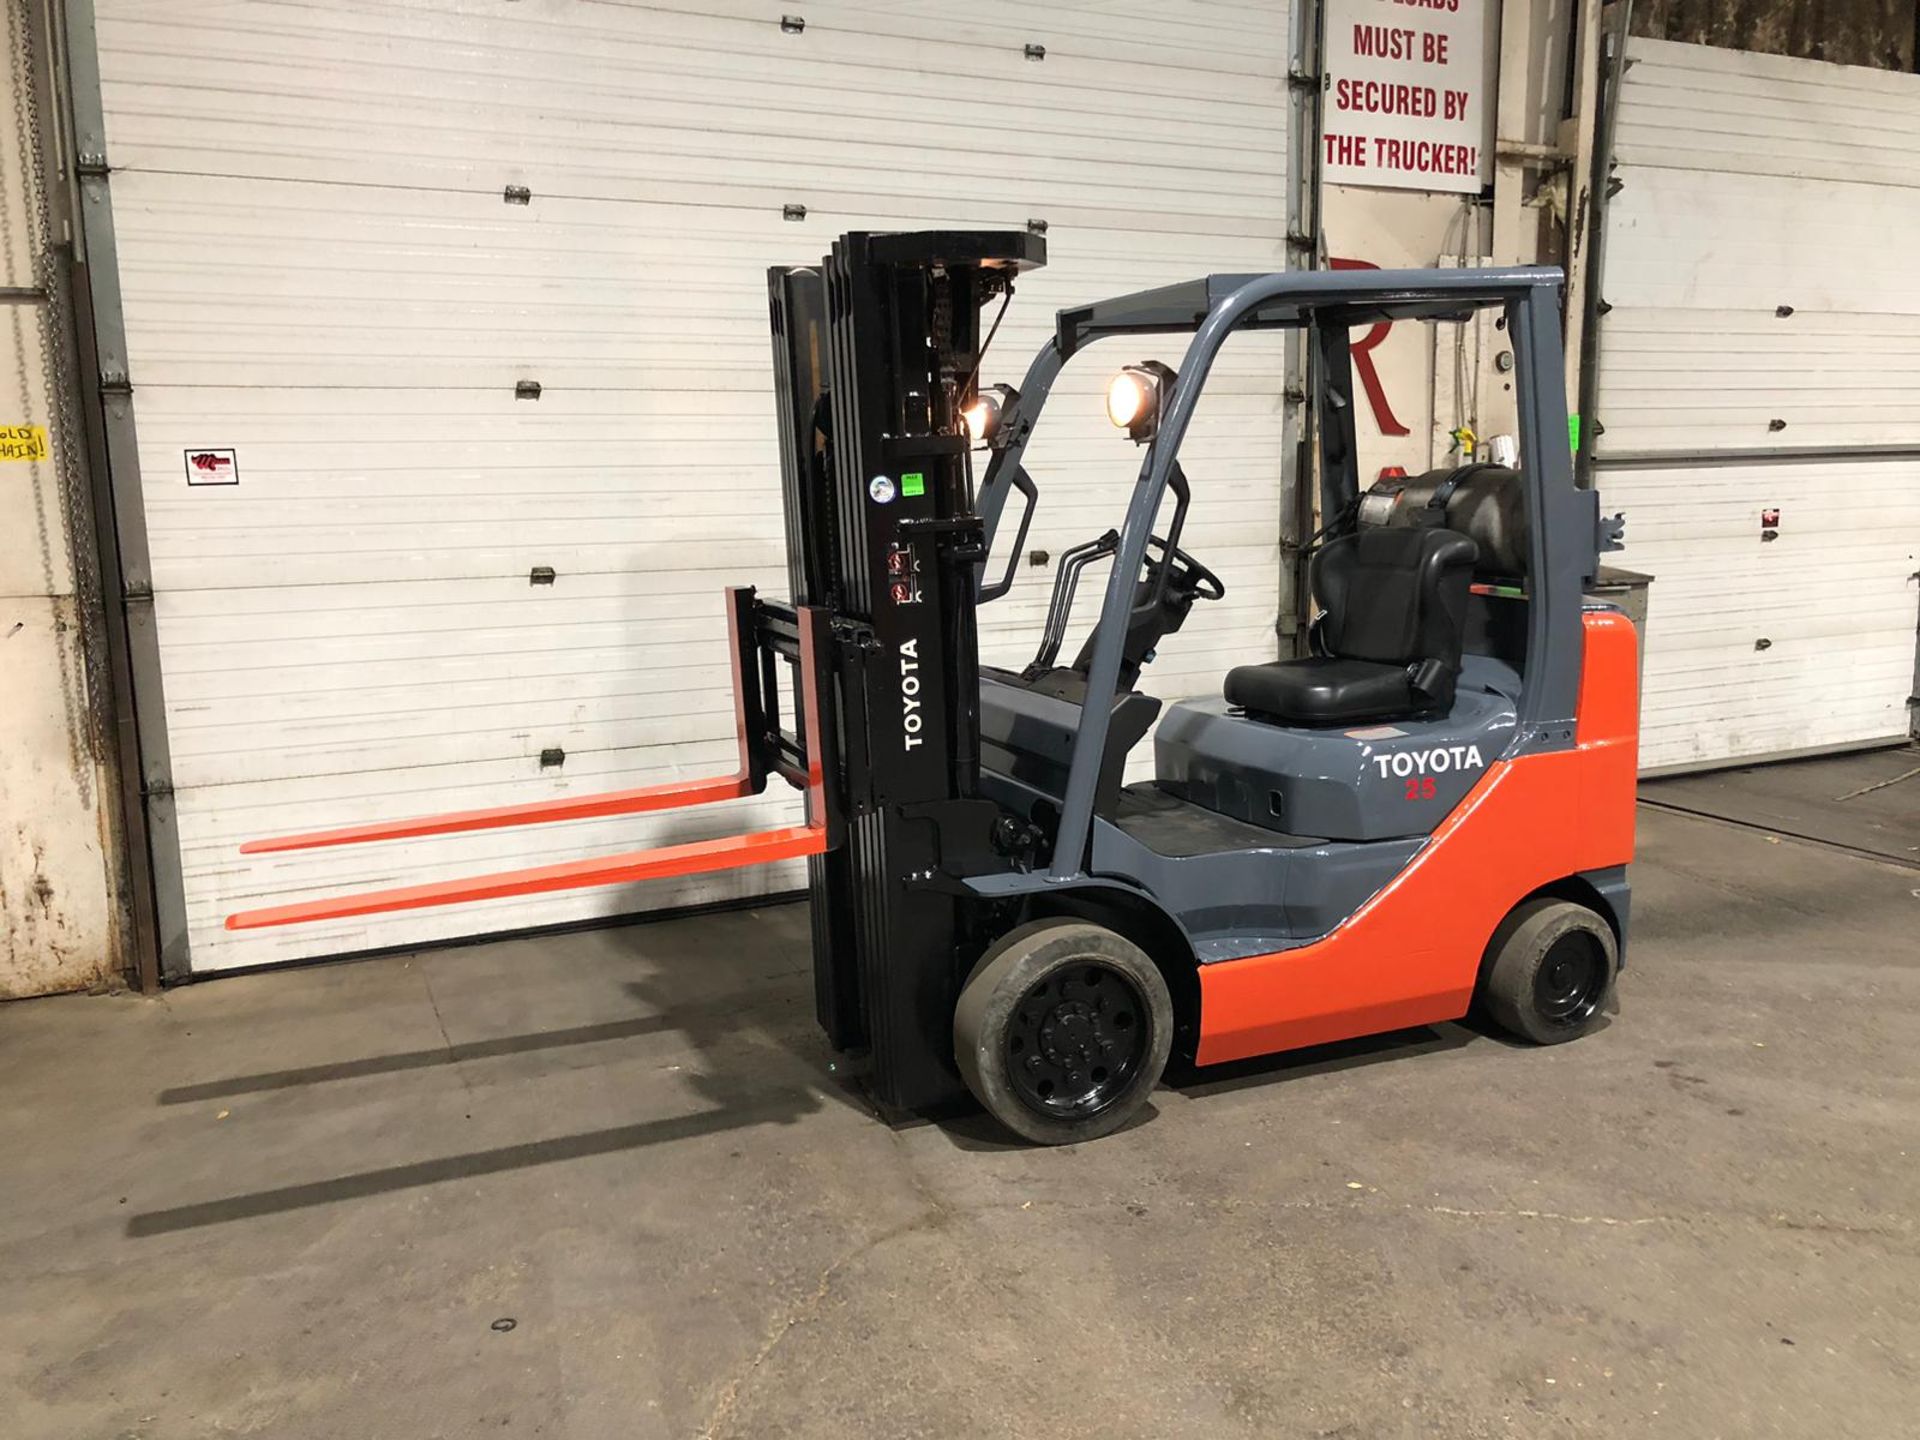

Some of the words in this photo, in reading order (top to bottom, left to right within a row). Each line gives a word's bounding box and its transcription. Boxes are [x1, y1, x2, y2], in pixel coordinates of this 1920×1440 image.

[1353, 24, 1416, 61] MUST
[1422, 33, 1449, 65] BE
[1336, 78, 1437, 118] SECURED
[1443, 90, 1469, 121] BY
[1323, 134, 1367, 167] THE
[1373, 138, 1477, 176] TRUCKER!
[899, 637, 923, 751] TOYOTA
[1372, 744, 1484, 779] TOYOTA
[1404, 777, 1437, 801] 25
